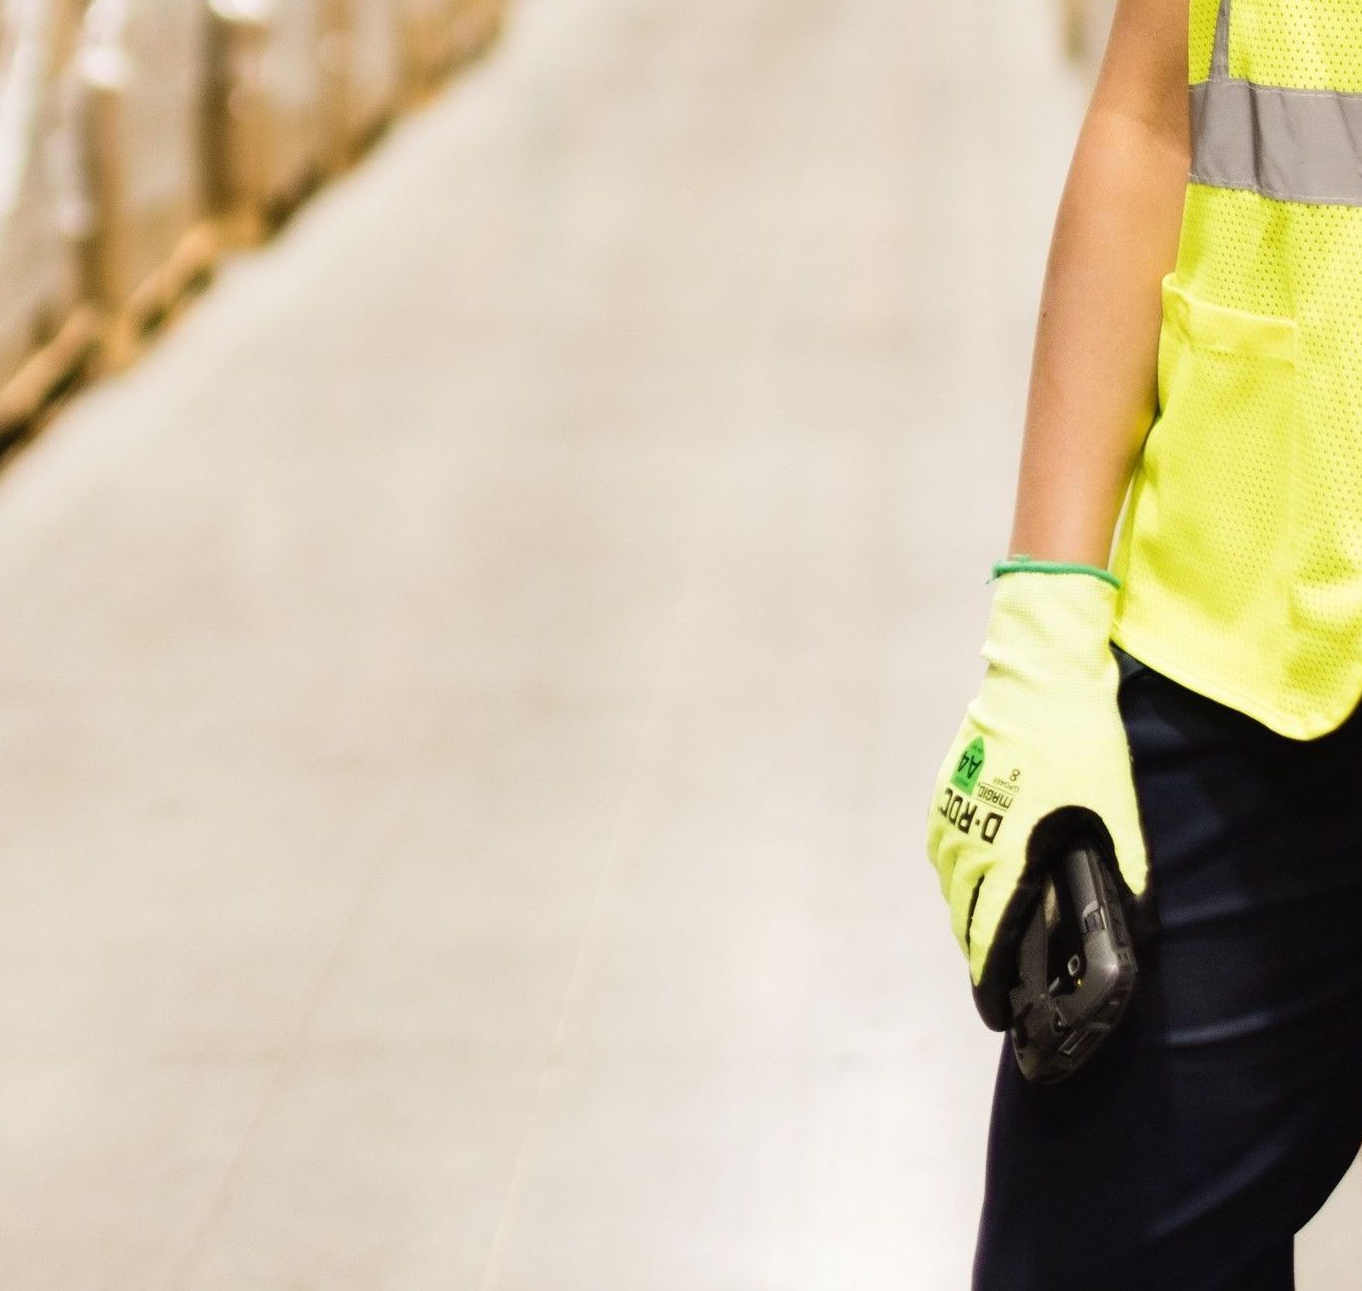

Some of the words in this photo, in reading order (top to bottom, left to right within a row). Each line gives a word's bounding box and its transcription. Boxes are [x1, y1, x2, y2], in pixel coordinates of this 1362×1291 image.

[957, 750, 983, 780] A4
[1009, 768, 1021, 782] 8
[977, 785, 1014, 810] MAGID
